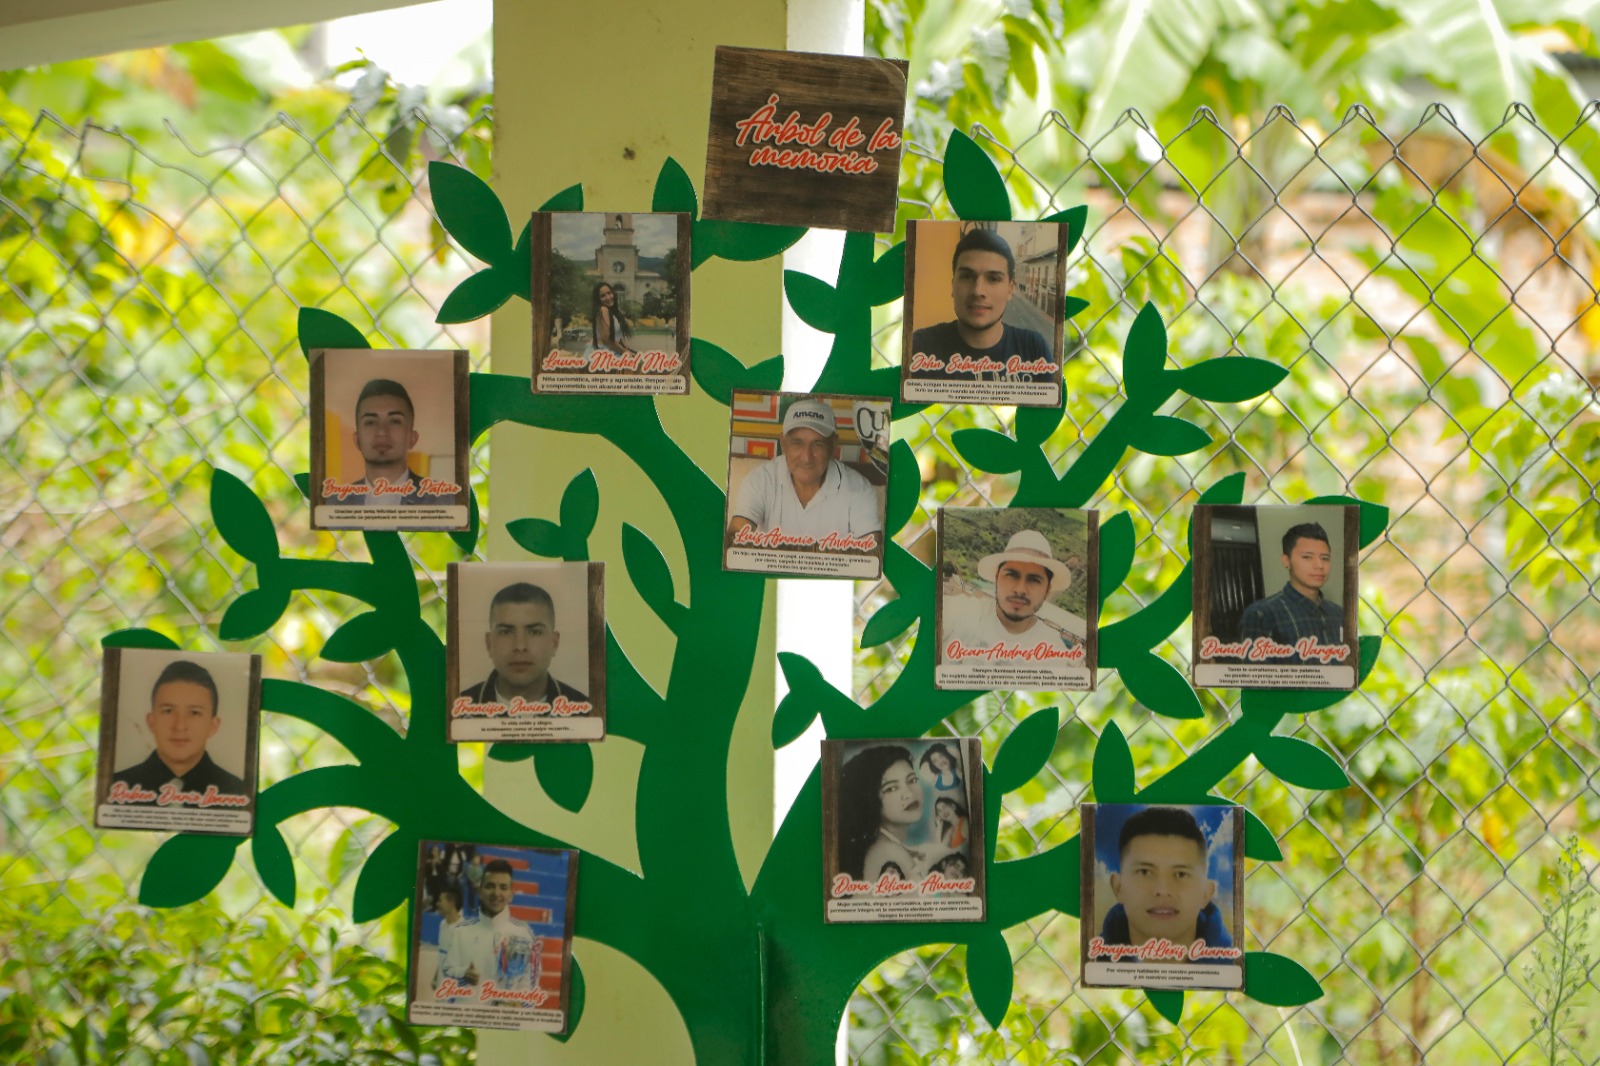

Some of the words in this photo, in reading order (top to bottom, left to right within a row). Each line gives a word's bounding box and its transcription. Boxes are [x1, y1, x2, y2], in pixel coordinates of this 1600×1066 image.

[736, 94, 831, 146] Árbol
[829, 117, 865, 151] de
[867, 118, 901, 152] la
[750, 146, 877, 173] memoria
[543, 350, 586, 369] Laura
[590, 350, 641, 371] Michel
[643, 352, 680, 372] Melo
[911, 353, 943, 371] John
[946, 354, 1004, 373] Sebastian
[1006, 355, 1058, 373] Quintero
[374, 479, 415, 495] Danilo
[736, 525, 762, 545] Luis
[762, 527, 814, 547] Afranio
[819, 532, 876, 551] Andrade
[947, 641, 985, 659] Oscar
[985, 642, 1034, 660] Andres
[1033, 642, 1083, 660] Obando
[1201, 637, 1251, 658] Daniel
[1249, 638, 1294, 660] Stiven
[1296, 637, 1349, 663] Vargas
[453, 698, 506, 716] Francisco
[509, 697, 551, 716] Javier
[552, 697, 591, 716] Rosero
[833, 875, 870, 895] Dora
[874, 874, 913, 895] Lilian
[919, 872, 974, 894] Alvarez
[1090, 938, 1139, 961] Brayan
[1190, 939, 1240, 960] Cuaran
[435, 980, 473, 998] Elian
[480, 981, 547, 1004] Benavides
